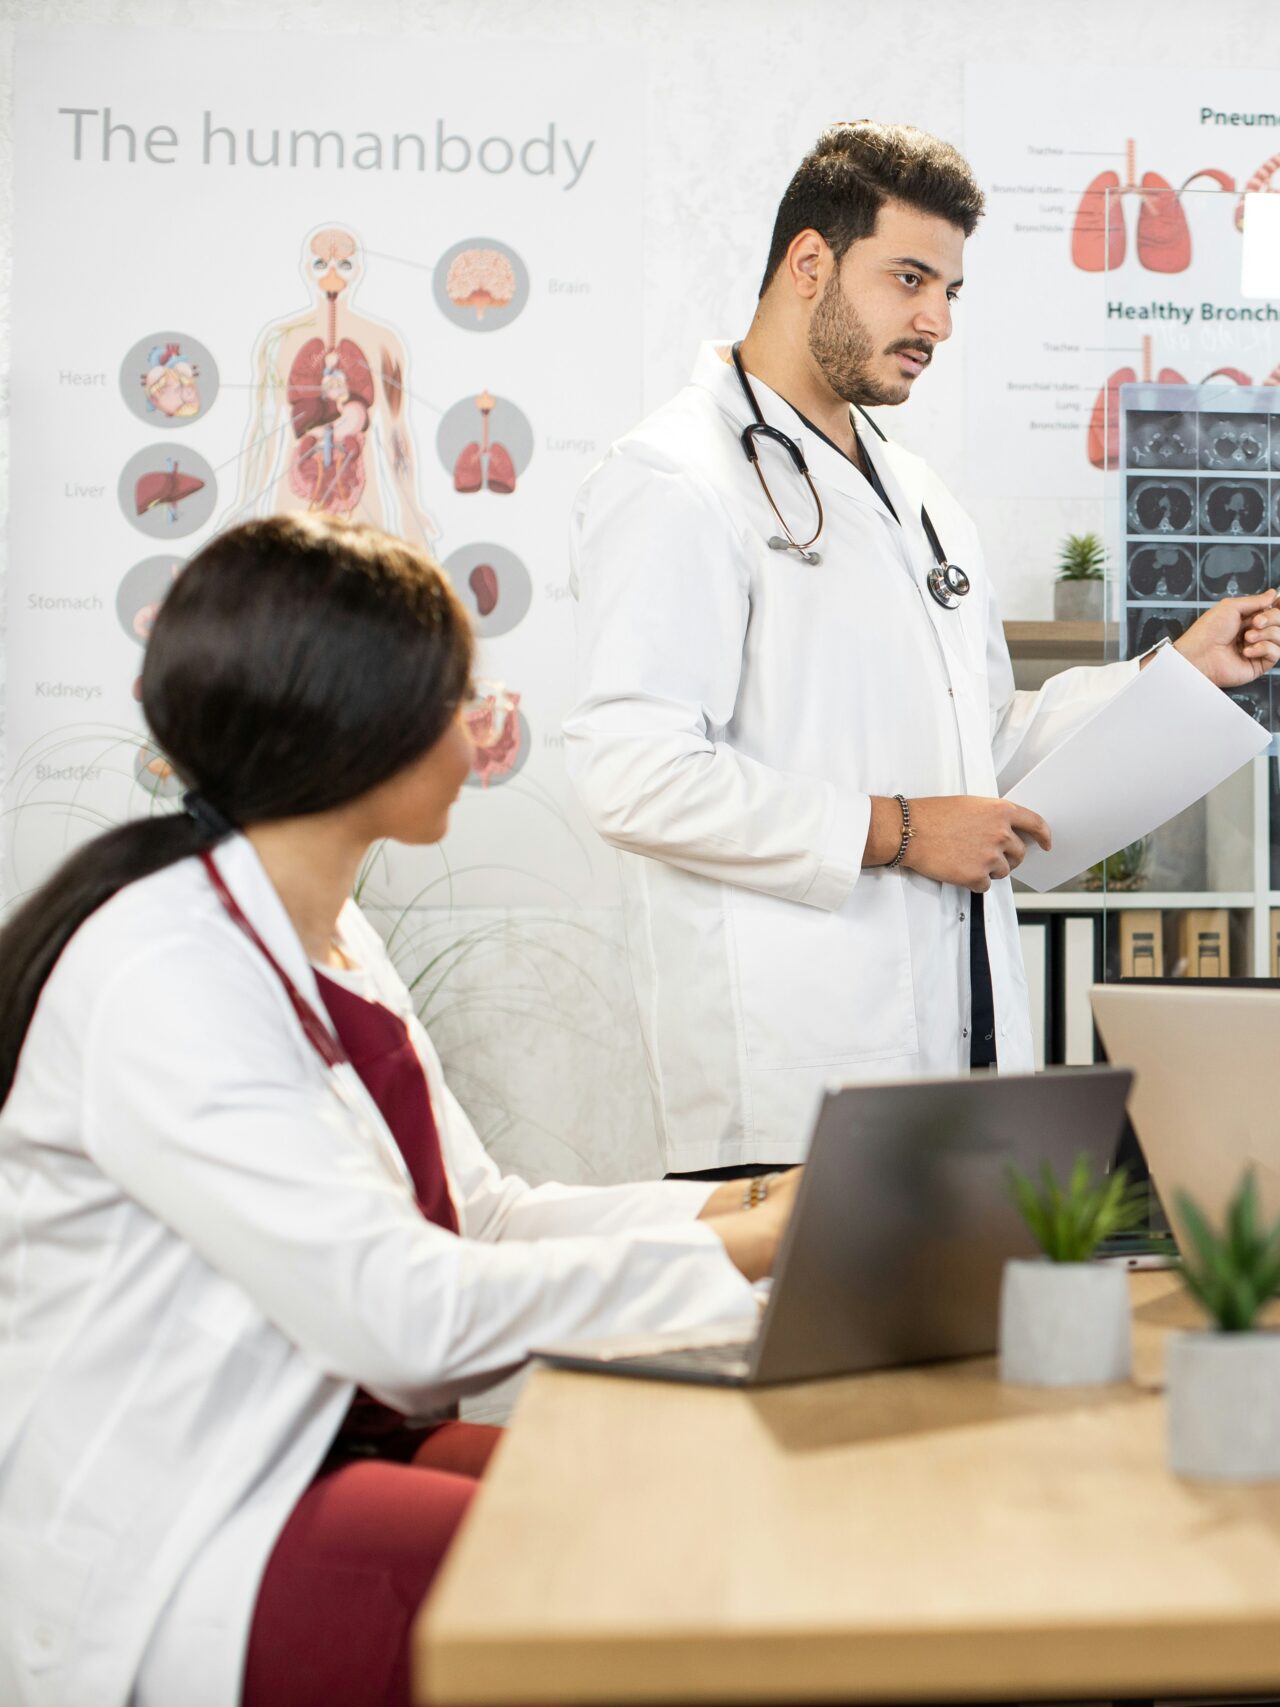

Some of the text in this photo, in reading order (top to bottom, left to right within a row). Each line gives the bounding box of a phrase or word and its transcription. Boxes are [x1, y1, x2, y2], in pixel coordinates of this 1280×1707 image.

[58, 106, 597, 192] The humanbody
[547, 277, 592, 296] Brain
[1107, 302, 1194, 325] Healthy
[58, 369, 107, 387] Heart
[546, 435, 597, 456] Lungs
[64, 481, 106, 499] Liver
[28, 593, 103, 611] Stomach
[35, 681, 103, 700] Kidneys
[36, 763, 102, 781] Bladder
